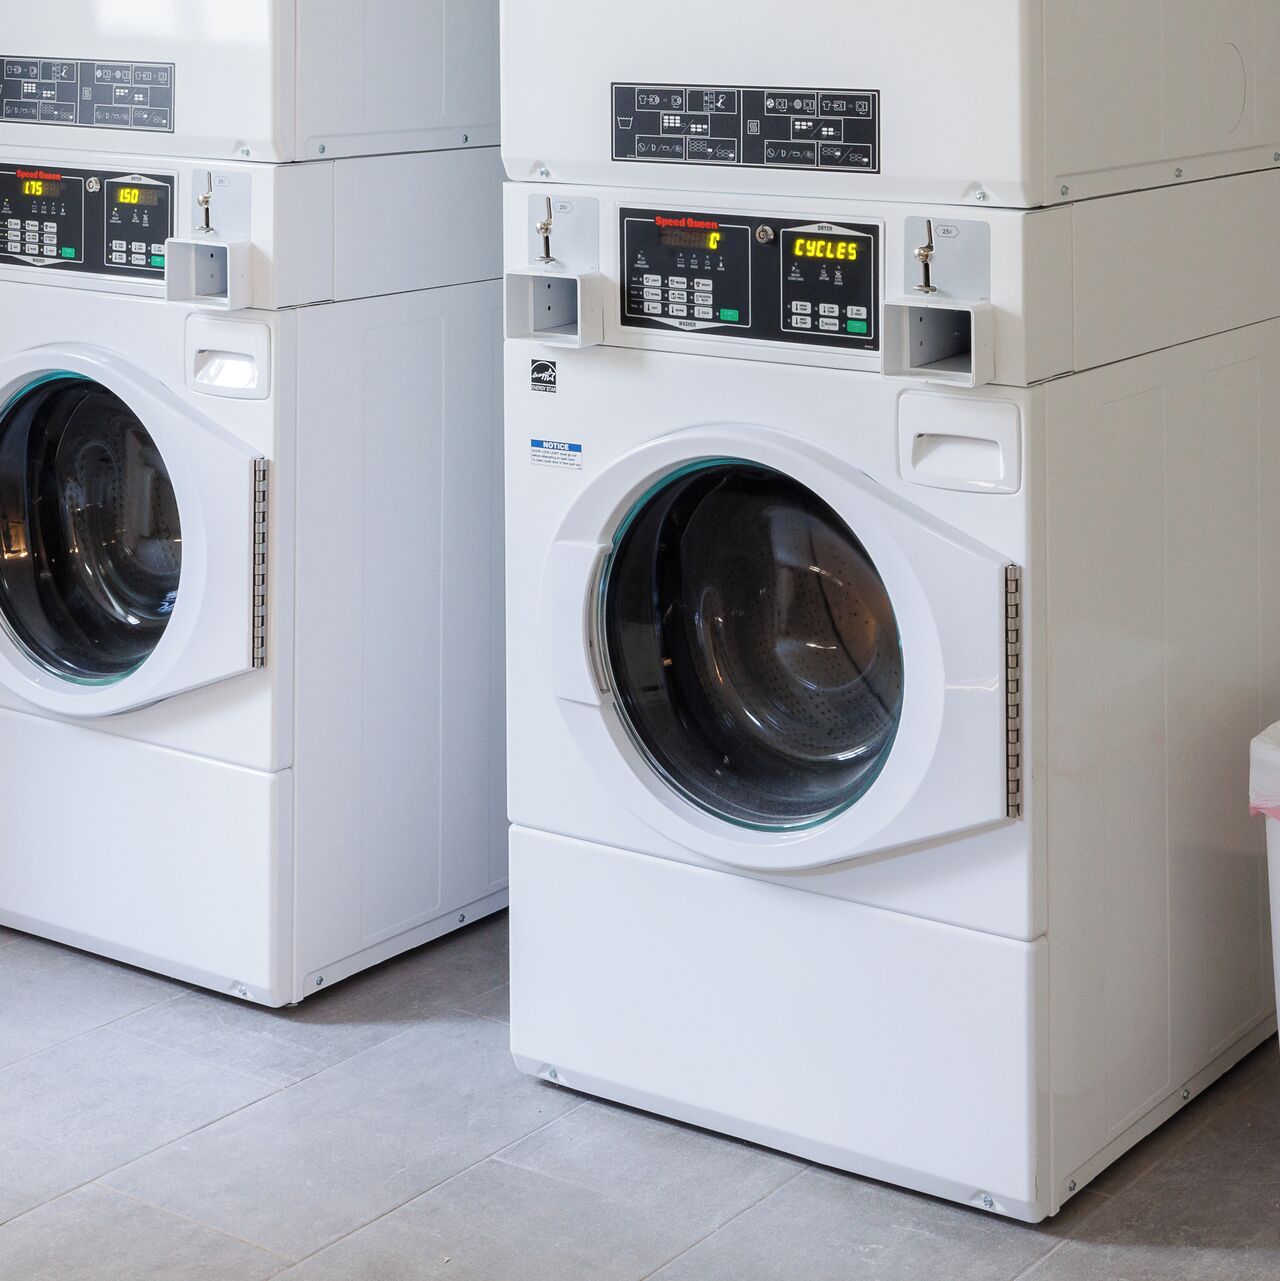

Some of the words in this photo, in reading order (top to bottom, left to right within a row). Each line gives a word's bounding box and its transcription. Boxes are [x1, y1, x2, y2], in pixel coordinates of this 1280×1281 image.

[16, 170, 38, 179] Speed
[38, 171, 61, 180] Queen
[655, 216, 686, 227] Speed
[687, 218, 718, 229] Queen
[795, 239, 857, 260] CYCLES
[543, 441, 570, 450] NOTICE
